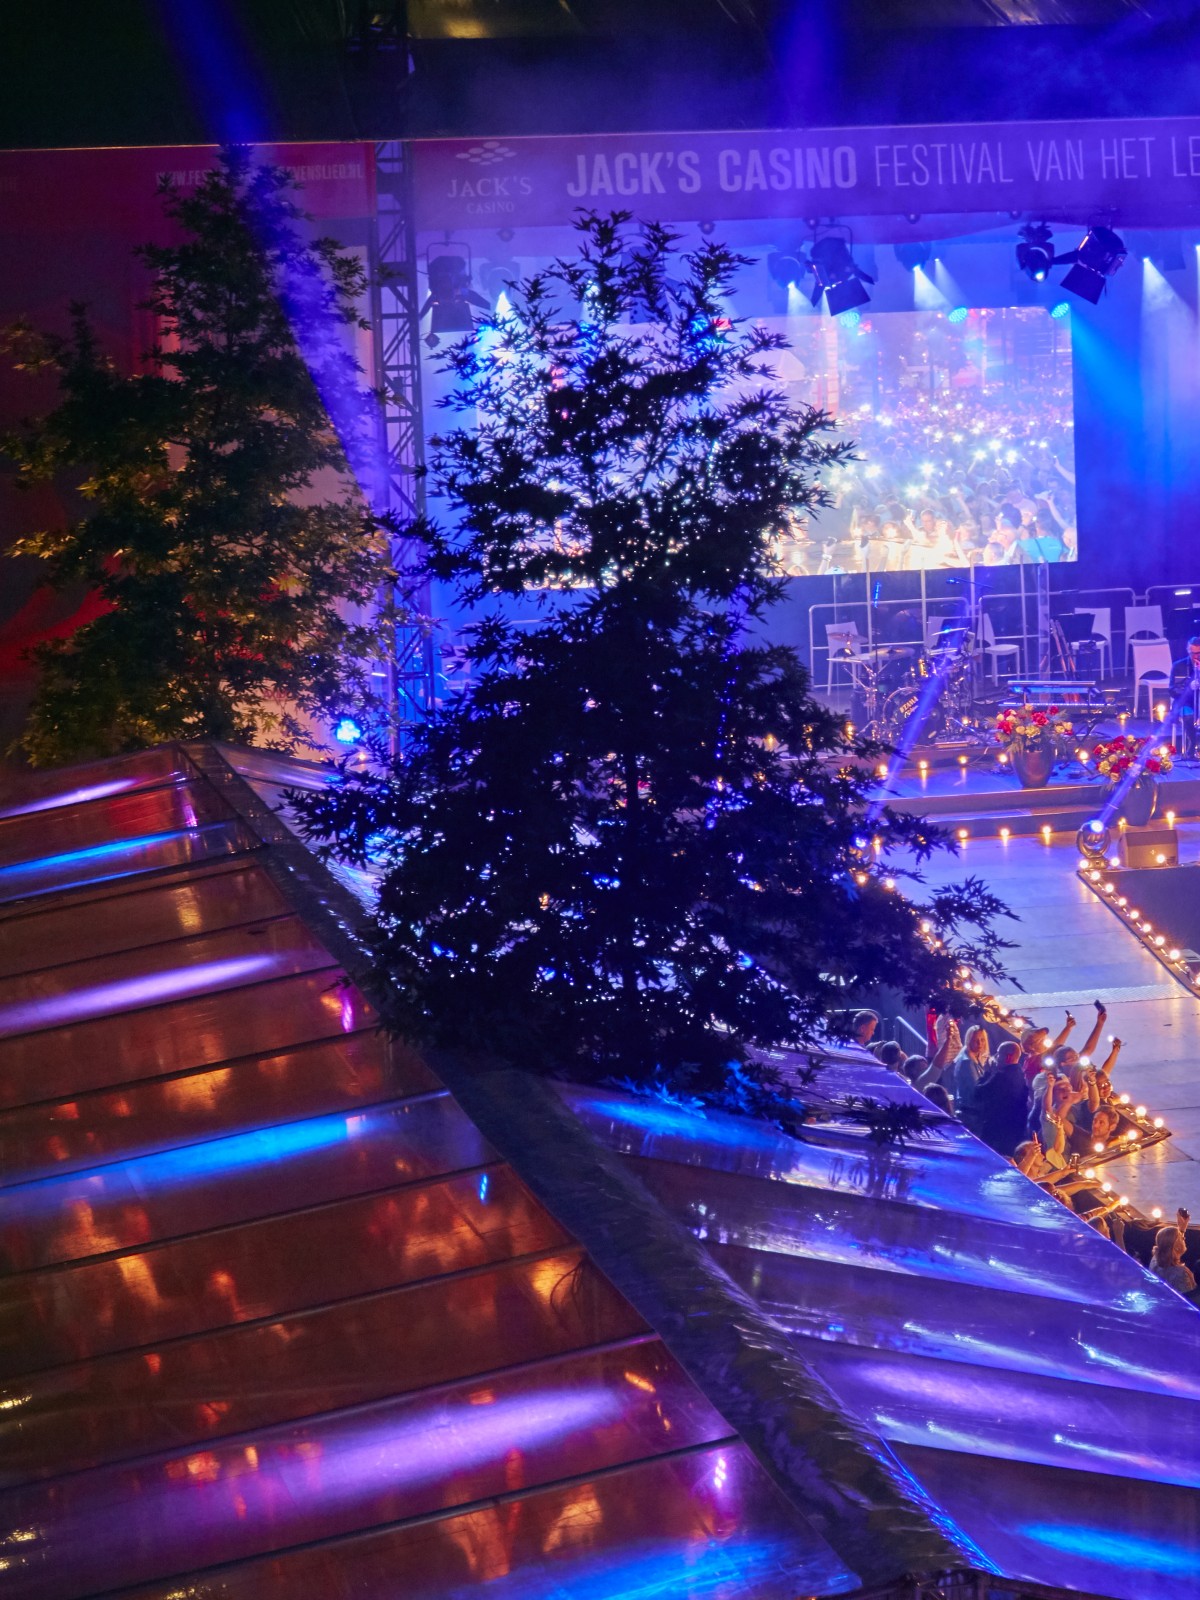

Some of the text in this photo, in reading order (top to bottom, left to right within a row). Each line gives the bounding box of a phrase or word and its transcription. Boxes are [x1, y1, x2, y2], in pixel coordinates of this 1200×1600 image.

[567, 150, 702, 197] JACK'S
[719, 145, 858, 192] CASINO
[875, 142, 1013, 187] FESTIVAL
[1027, 139, 1086, 181] VAN
[1101, 136, 1156, 180] HET
[447, 176, 532, 198] JACK'S
[466, 201, 516, 214] CASINO
